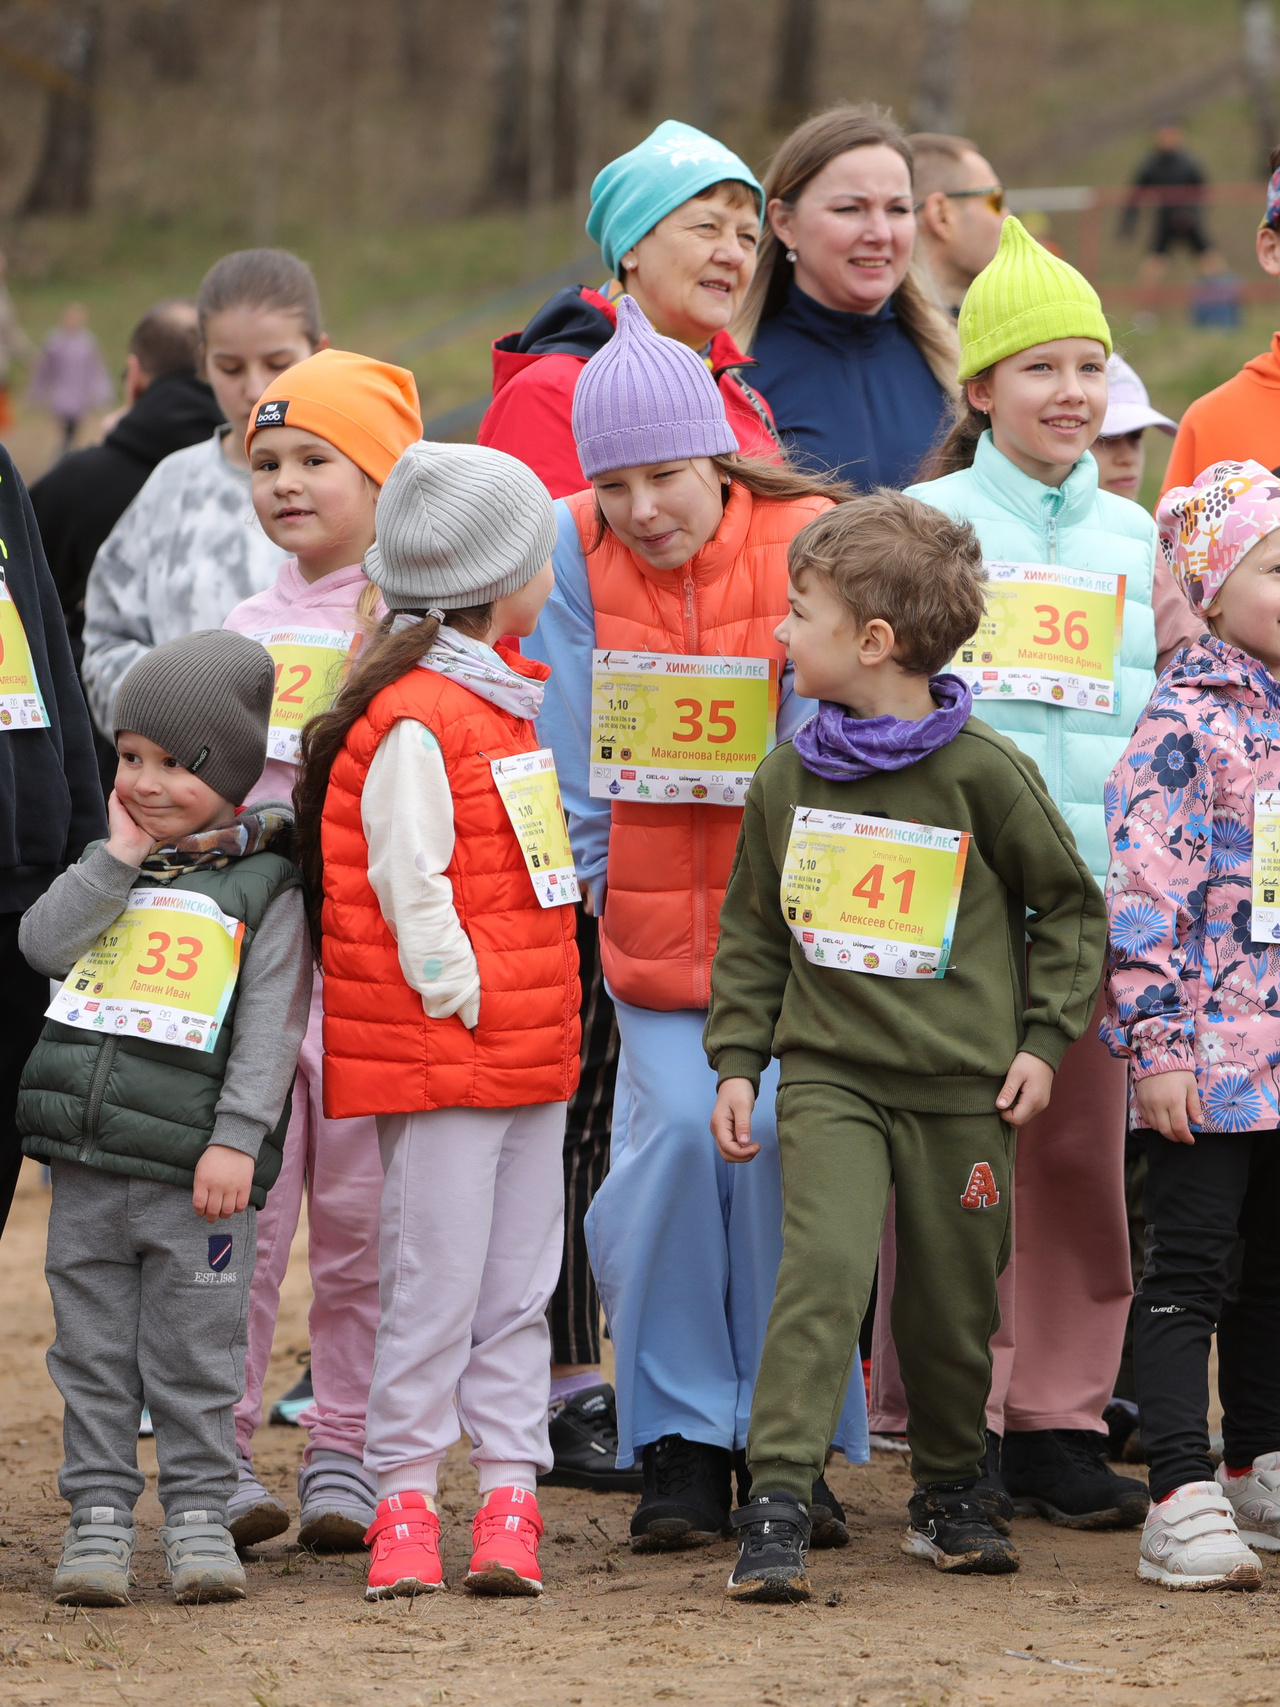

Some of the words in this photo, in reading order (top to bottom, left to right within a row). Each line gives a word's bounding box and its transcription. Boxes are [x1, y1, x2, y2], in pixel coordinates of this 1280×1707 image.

[257, 410, 281, 422] bodo
[1024, 570, 1093, 589] ХИМКИНСКИЙ
[1095, 580, 1113, 592] ЛЕС
[1033, 604, 1089, 651] 36
[1018, 649, 1074, 665] Макагонова
[1075, 655, 1102, 671] Арина
[666, 661, 743, 676] ХИМКИНСКИЙ
[745, 666, 765, 678] ЛЕС
[642, 683, 660, 693] 2024
[609, 699, 628, 711] 1,10
[273, 708, 304, 721] Мария
[672, 698, 737, 744] 35
[651, 746, 712, 761] Макагонова
[714, 749, 757, 764] Евдокия
[518, 804, 533, 819] 1,10
[853, 823, 933, 845] ХИМКИНСКИЙ
[935, 837, 954, 849] ЛЕС
[831, 845, 846, 853] 2024
[872, 849, 897, 863] Sminex
[898, 855, 912, 864] Run
[798, 858, 817, 871] 1,10
[852, 863, 916, 914] 41
[839, 911, 885, 928] Алексеев
[888, 919, 924, 935] Степан
[103, 936, 118, 948] 1,10
[822, 936, 844, 945] GEL4U
[137, 931, 204, 981] 33
[129, 980, 163, 995] Лапкин
[165, 984, 192, 1000] Иван
[193, 1271, 237, 1284] EST.1985
